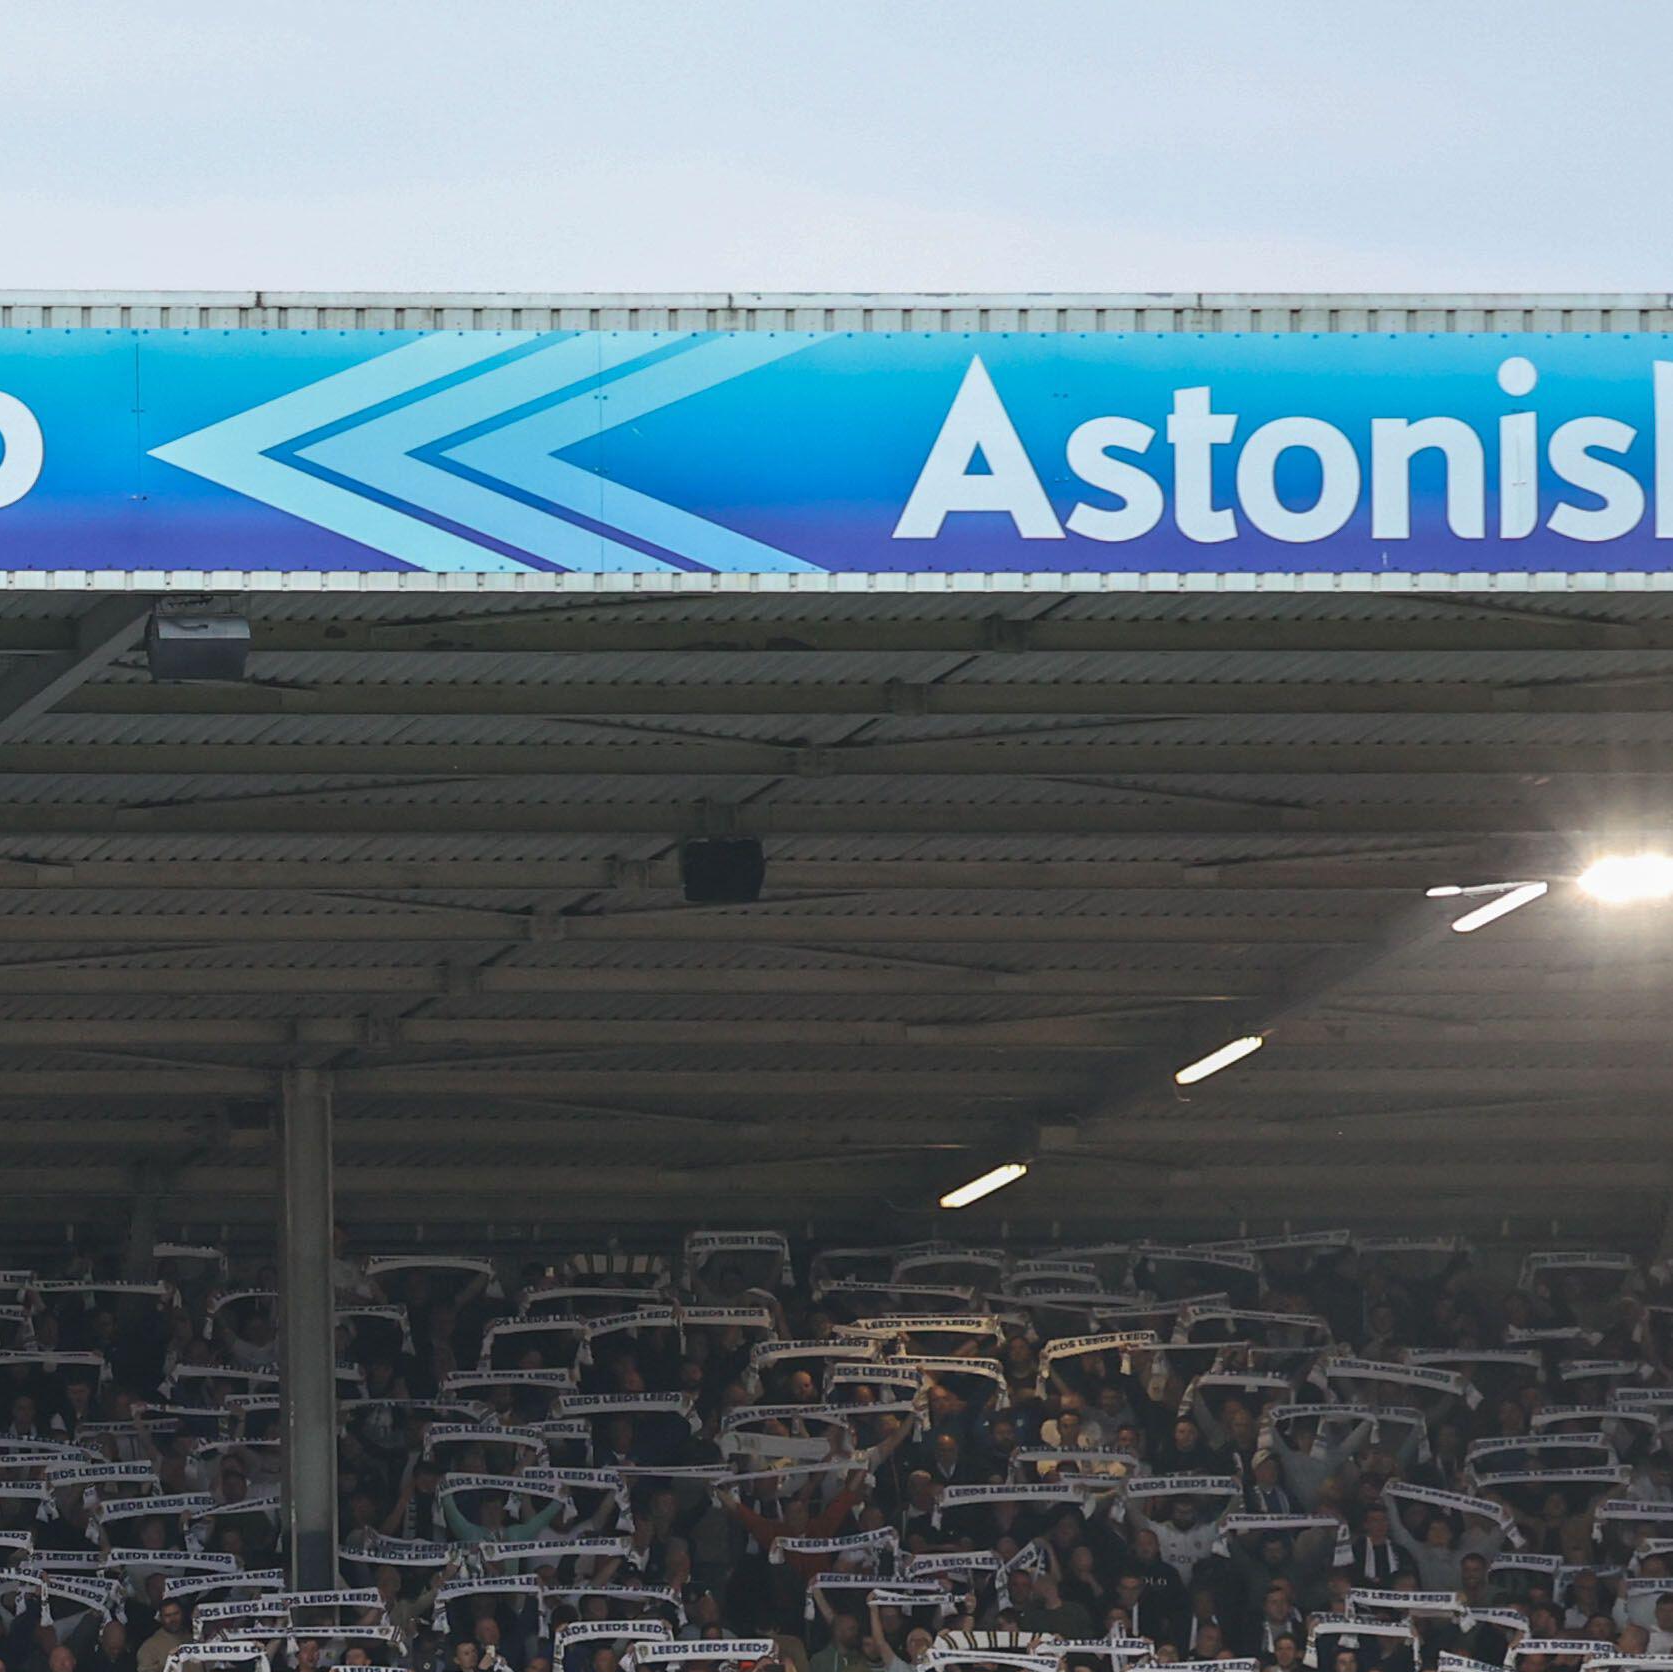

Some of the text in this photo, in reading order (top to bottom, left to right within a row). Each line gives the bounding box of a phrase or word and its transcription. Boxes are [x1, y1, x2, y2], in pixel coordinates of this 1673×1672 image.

[892, 354, 1673, 544] Astonis
[652, 1641, 769, 1655] LEEDS LEEDS LEEDS
